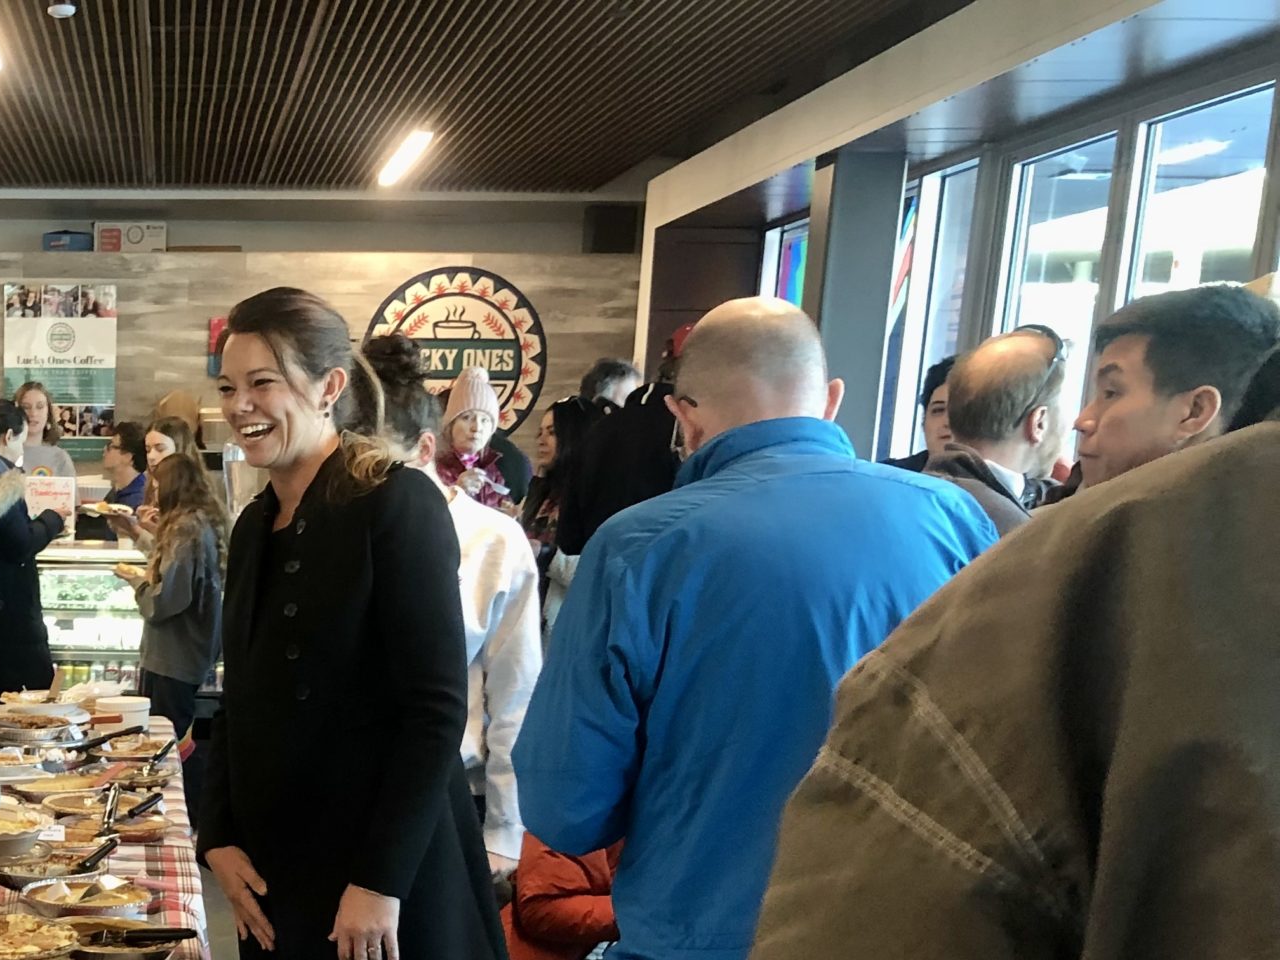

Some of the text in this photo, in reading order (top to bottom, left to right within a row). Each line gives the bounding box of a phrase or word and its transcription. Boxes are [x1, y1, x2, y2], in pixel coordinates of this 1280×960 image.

[16, 355, 105, 367] Lucky Ones Coffee
[462, 348, 515, 371] ONES
